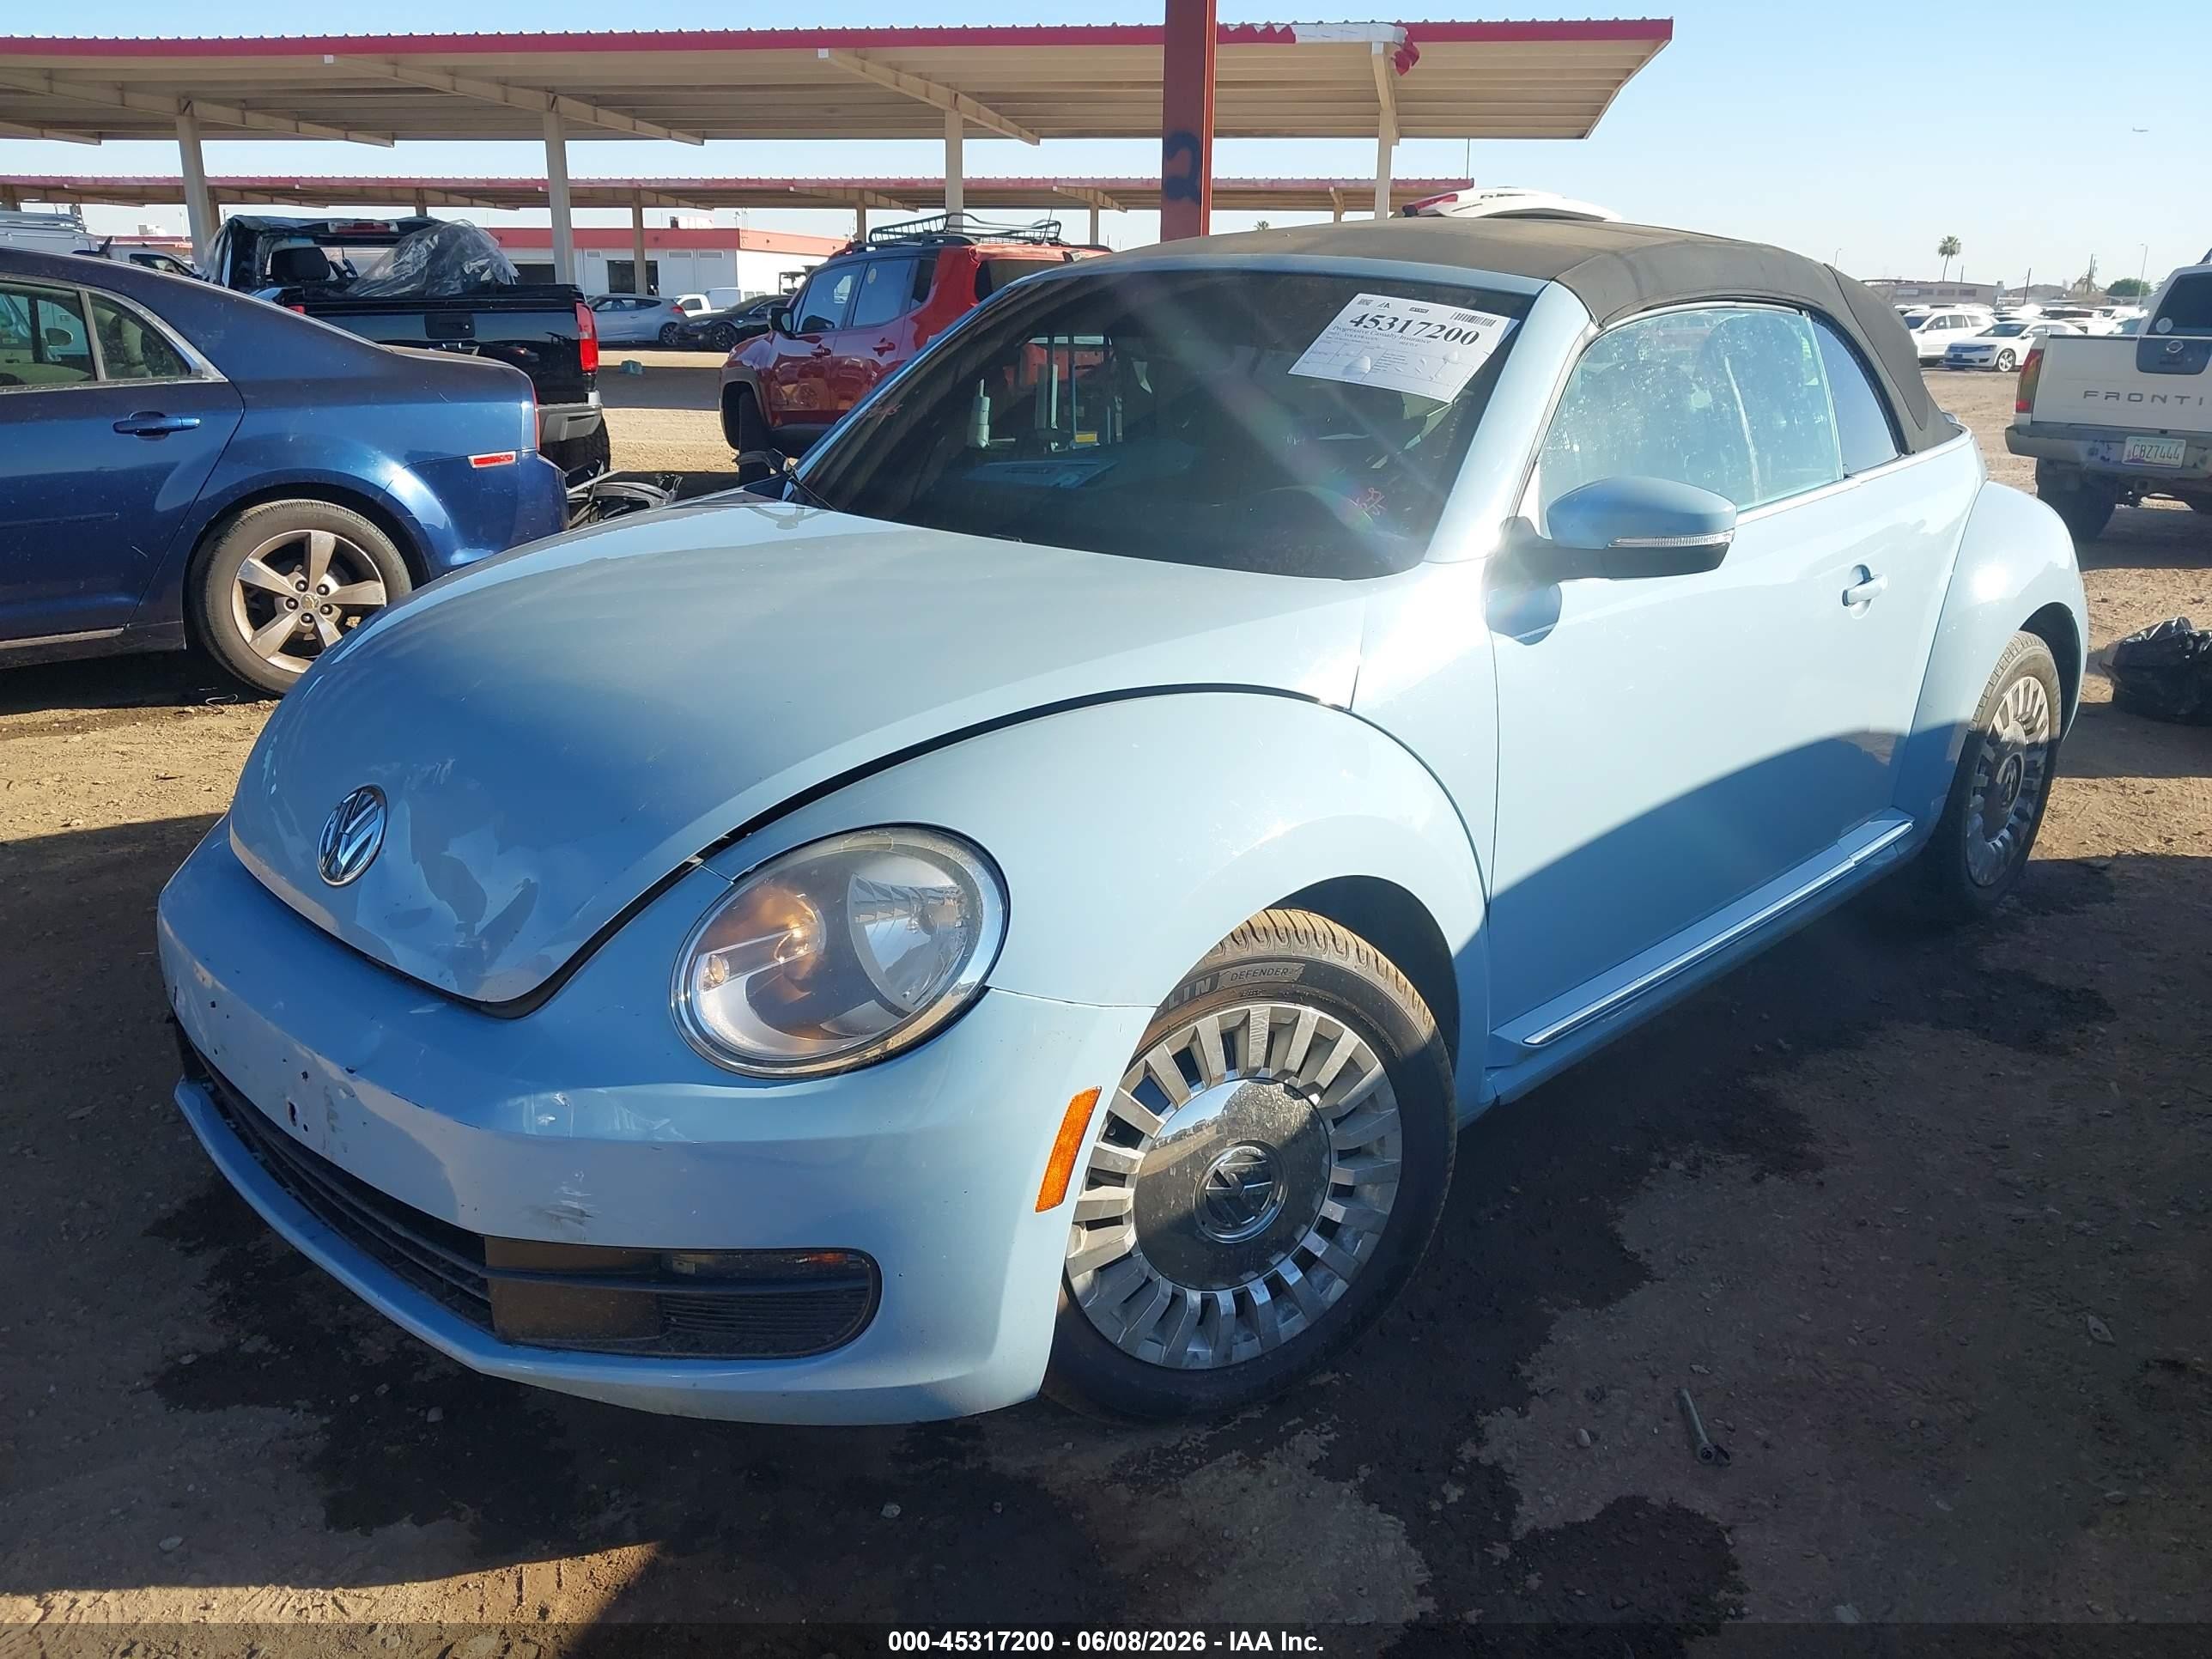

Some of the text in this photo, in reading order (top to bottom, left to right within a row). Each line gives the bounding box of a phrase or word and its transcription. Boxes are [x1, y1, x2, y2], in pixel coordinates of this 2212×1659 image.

[1349, 313, 1480, 345] 45317200
[2083, 390, 2205, 406] FRONTI
[1165, 977, 1211, 1011] LIN
